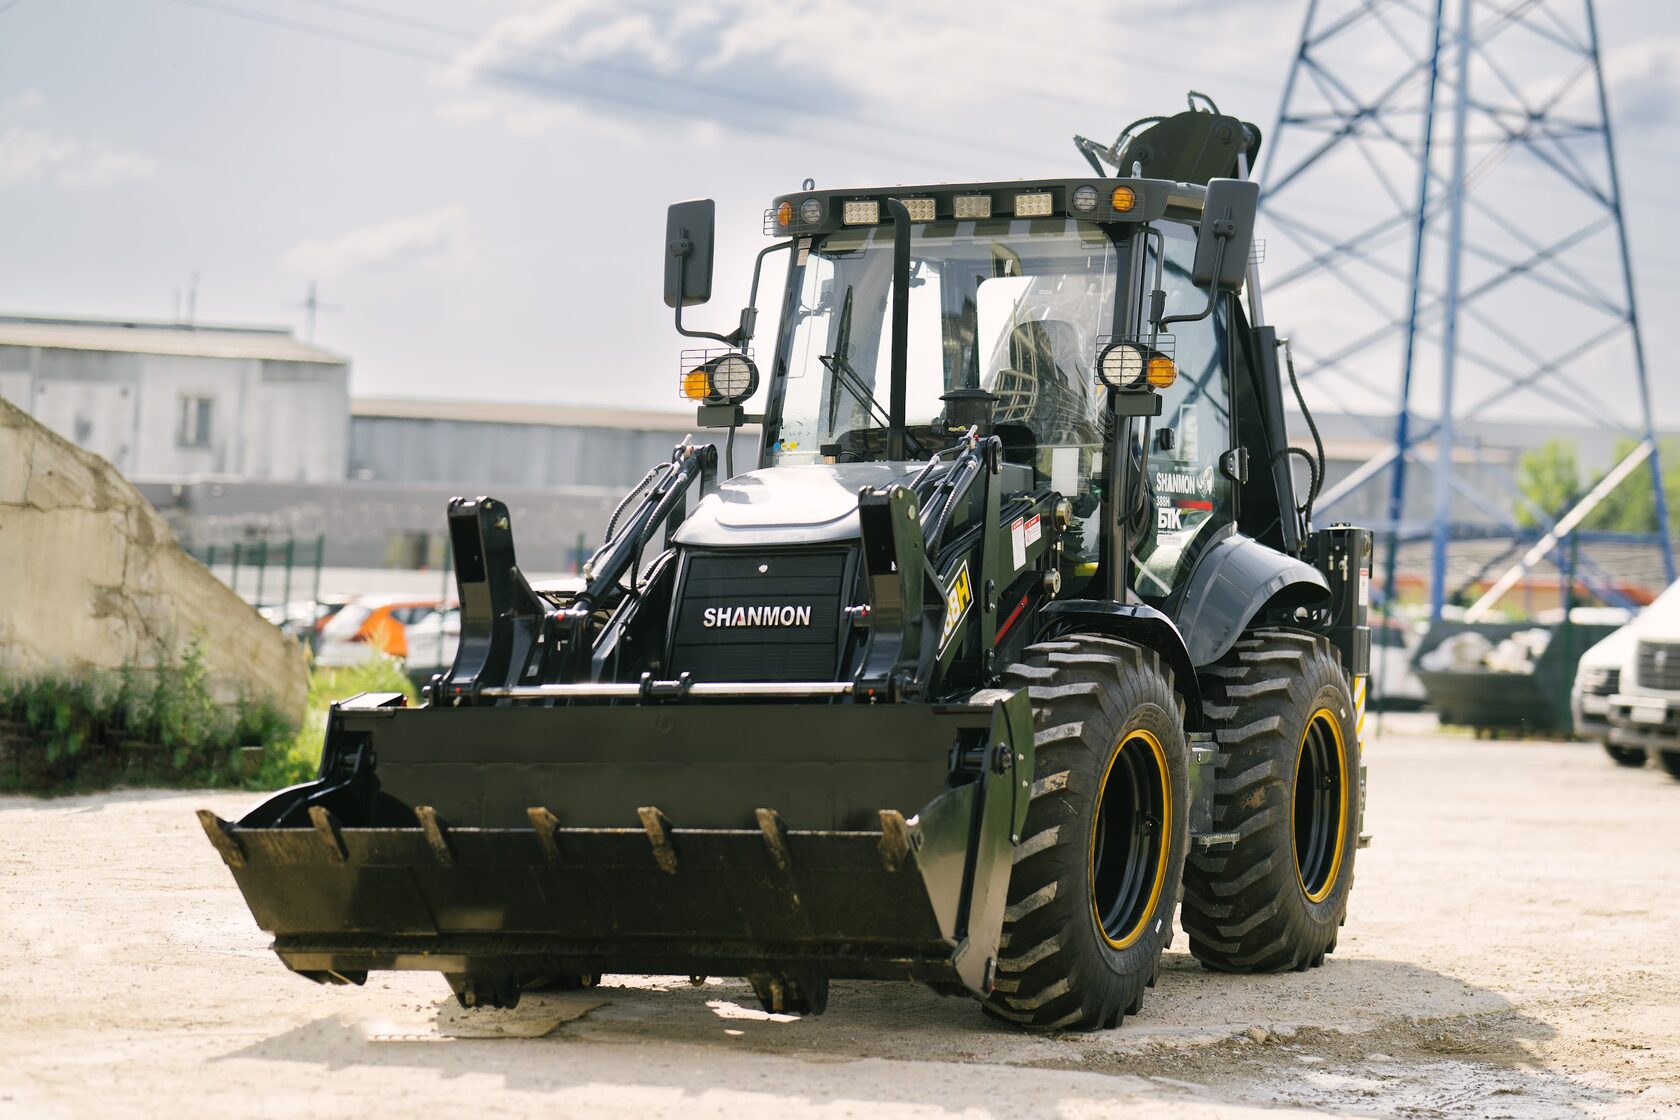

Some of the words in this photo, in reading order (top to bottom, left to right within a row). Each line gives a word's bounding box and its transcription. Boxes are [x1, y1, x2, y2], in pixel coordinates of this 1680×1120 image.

[1156, 472, 1196, 494] SHANMON
[703, 606, 811, 627] SHANMON
[939, 570, 971, 649] 88H
